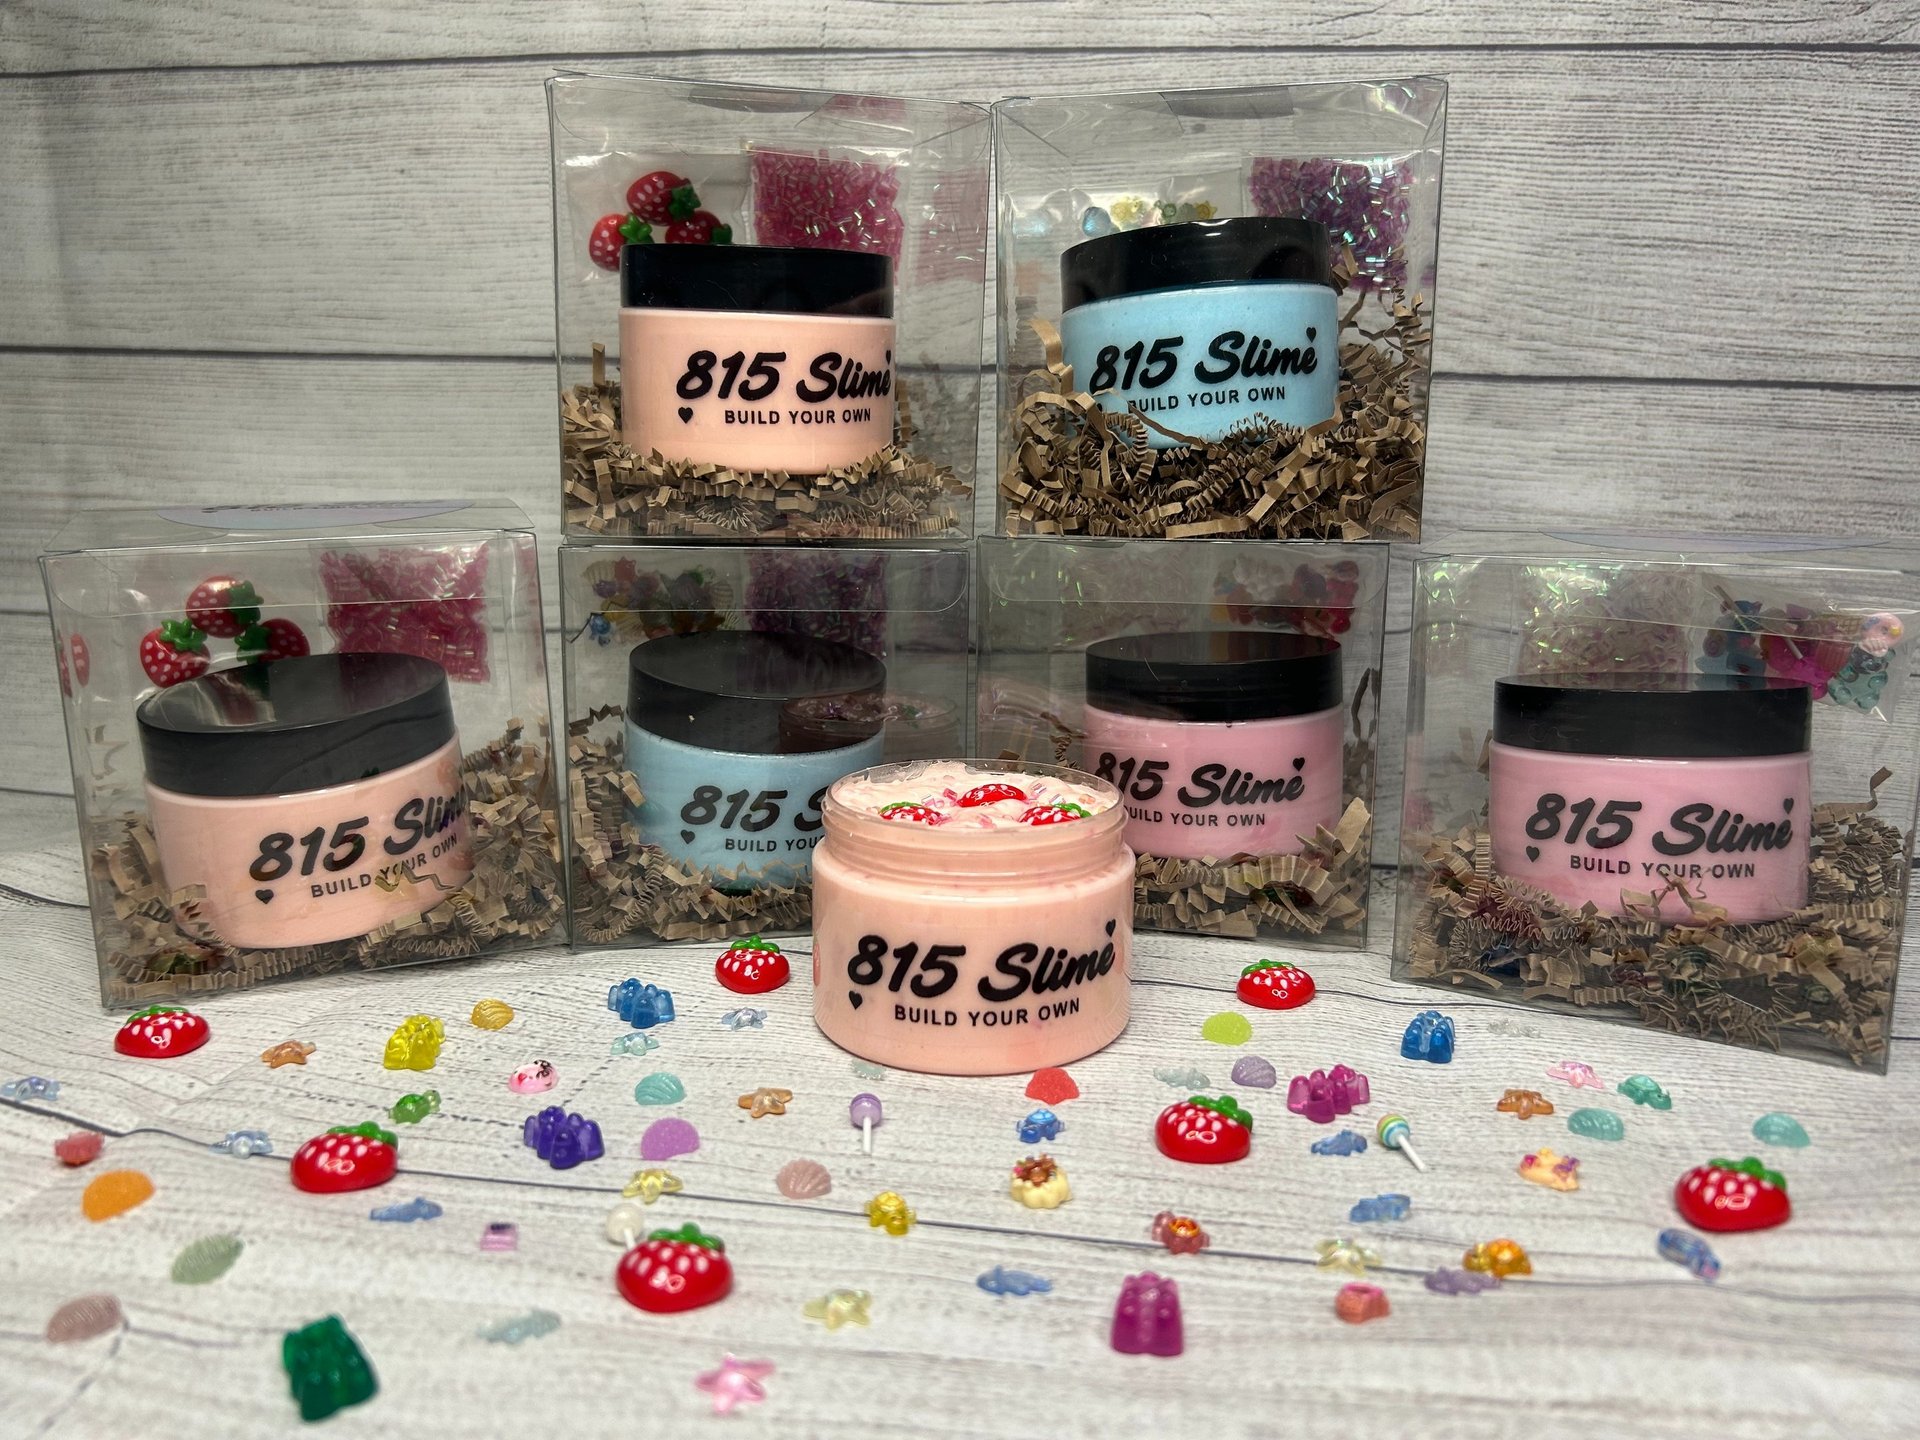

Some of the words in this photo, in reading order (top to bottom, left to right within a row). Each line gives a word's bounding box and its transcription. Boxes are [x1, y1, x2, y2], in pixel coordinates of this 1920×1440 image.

[676, 350, 787, 401] 815
[796, 352, 892, 403] Slime
[1089, 335, 1184, 395] 815
[1194, 330, 1318, 384] Slime
[724, 409, 780, 425] BUILD
[788, 409, 836, 425] YOUR
[842, 407, 871, 422] OWN
[1188, 389, 1240, 407] YOUR
[1247, 386, 1286, 401] OWN
[1094, 752, 1169, 801] 815
[1177, 763, 1305, 808] Slime
[680, 785, 788, 832] 815
[1170, 812, 1218, 827] YOUR
[1226, 813, 1266, 827] OWN
[1525, 793, 1643, 849] 815
[1651, 802, 1793, 857] Slime
[249, 815, 369, 882] 815
[383, 788, 465, 855] Slim
[725, 838, 777, 852] BUILD
[785, 834, 826, 851] YOU
[311, 873, 371, 898] BUILD
[432, 833, 458, 859] OWN
[1570, 855, 1631, 875] BUILD
[1711, 863, 1756, 879] OWN
[847, 934, 967, 999] 815
[977, 942, 1116, 1002] Slime
[895, 1004, 958, 1027] BUILD
[968, 1008, 1029, 1027] YOUR
[1038, 998, 1080, 1021] OWN
